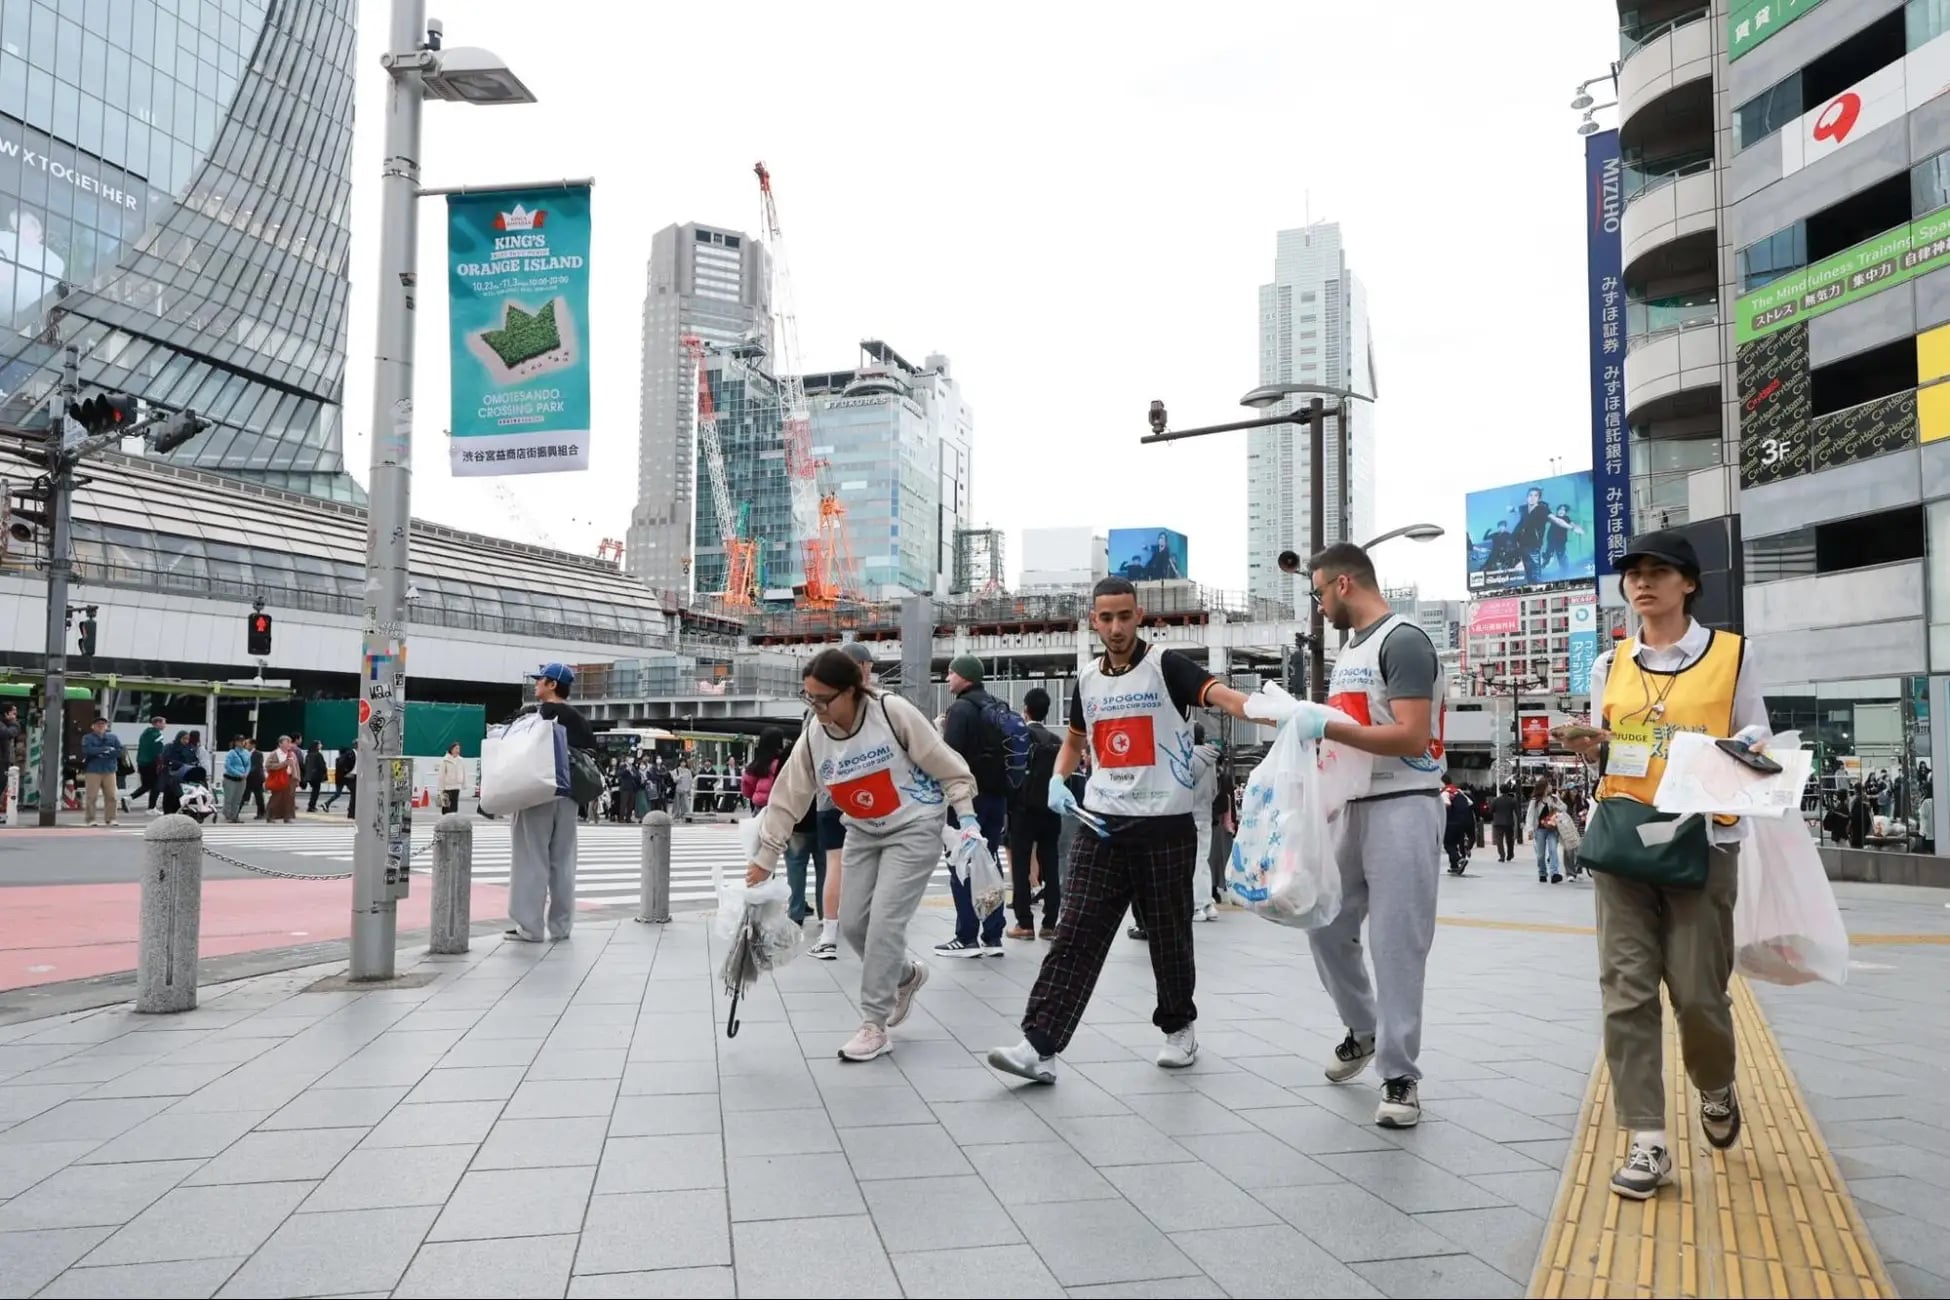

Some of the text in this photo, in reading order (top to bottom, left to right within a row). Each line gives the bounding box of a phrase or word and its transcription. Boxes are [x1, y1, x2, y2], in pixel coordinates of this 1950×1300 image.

[39, 155, 137, 211] TOGETHER
[1602, 156, 1620, 233] MIZUHO
[495, 235, 545, 250] KING'S
[457, 255, 583, 277] ORANGE ISLAND
[1752, 294, 1773, 310] The
[1776, 261, 1853, 299] Mindfulness
[1858, 234, 1915, 265] Training
[1756, 304, 1793, 327] ストレス
[1804, 284, 1840, 307] 無気力
[1852, 262, 1892, 288] 集中力
[483, 388, 561, 405] OMOTESANDO
[478, 401, 565, 418] CROSSING PARK
[1602, 277, 1626, 566] みずほ証券 みずほ信託銀行 みずほ銀行
[1761, 438, 1791, 465] 3F
[1103, 692, 1158, 704] SPOGOMI
[1615, 732, 1648, 742] JUDGE
[838, 745, 890, 769] SPOGOMI
